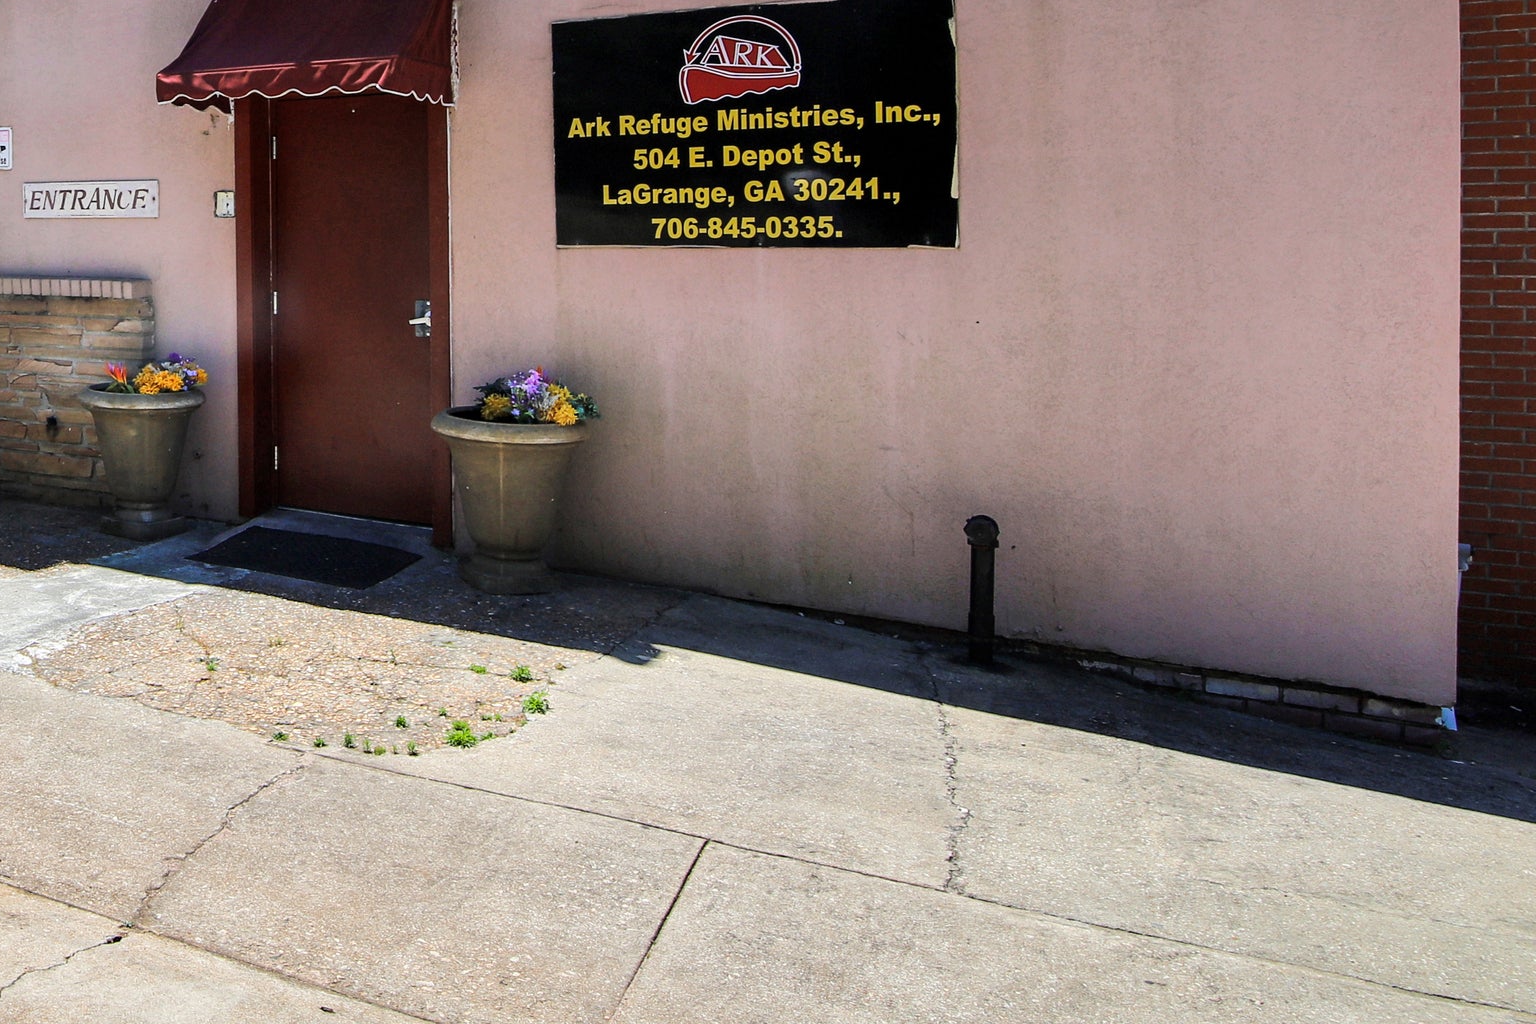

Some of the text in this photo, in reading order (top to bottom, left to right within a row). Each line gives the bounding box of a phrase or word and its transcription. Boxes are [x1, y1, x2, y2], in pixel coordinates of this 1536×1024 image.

[700, 35, 779, 67] ARK
[568, 101, 941, 138] Ark Refuge Ministries, Inc.,
[633, 141, 861, 171] 504 E. Depot St.,
[29, 187, 149, 211] ENTRANCE
[602, 176, 901, 209] LaGrange, GA 30241.,
[651, 215, 843, 240] 706-845-0335.
